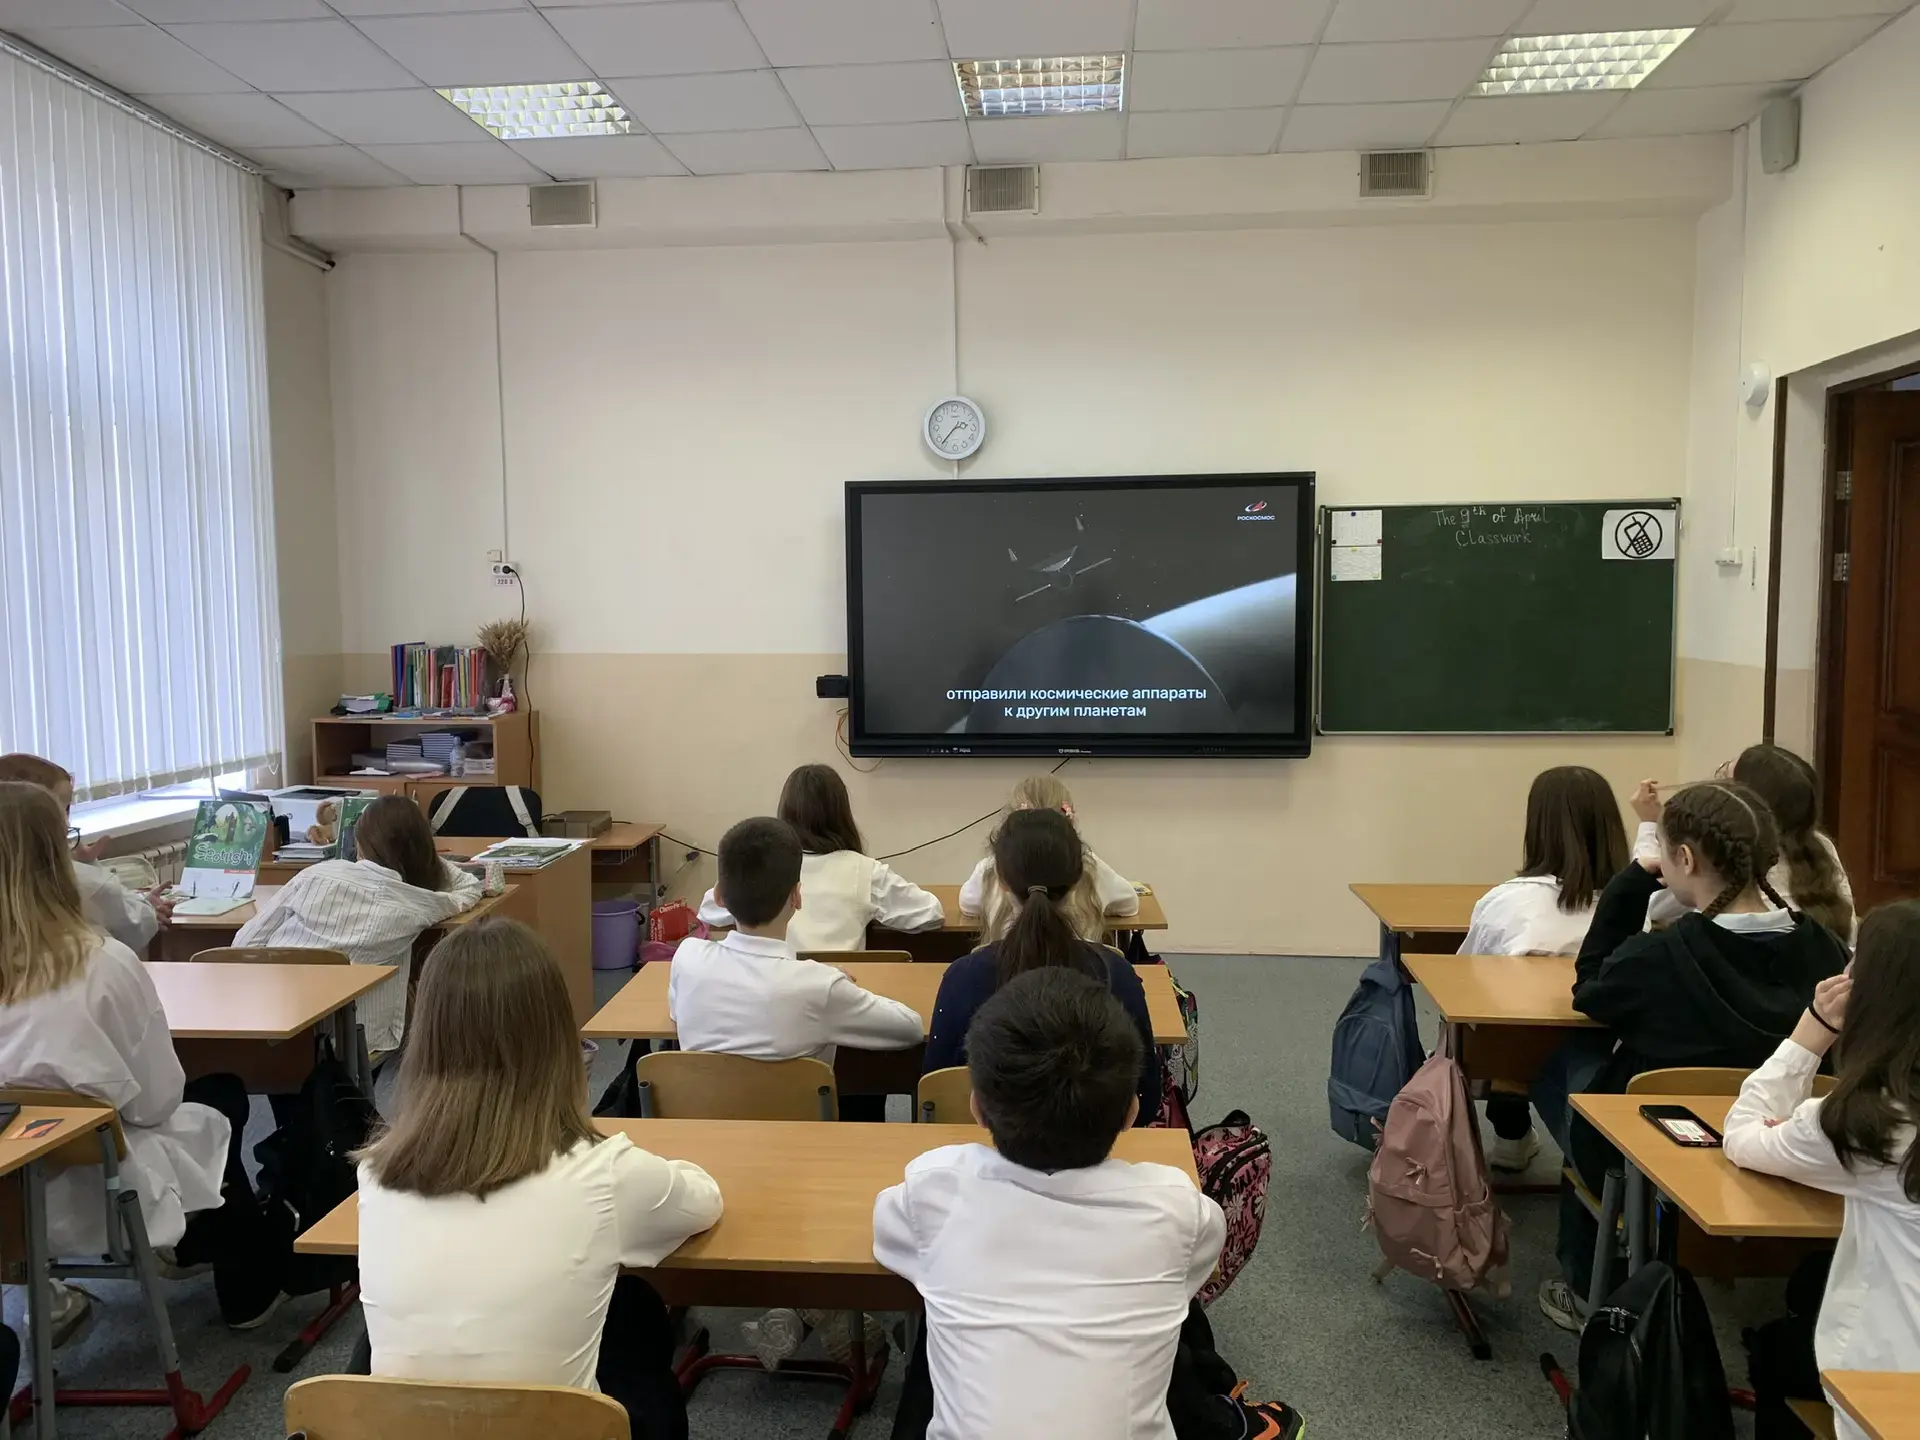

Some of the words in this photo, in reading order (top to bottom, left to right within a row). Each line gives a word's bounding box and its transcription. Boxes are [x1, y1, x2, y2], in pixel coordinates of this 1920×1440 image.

[951, 403, 959, 413] 12
[1431, 509, 1457, 526] The
[1492, 506, 1507, 523] of
[1513, 506, 1551, 530] April
[1455, 529, 1532, 547] Classwork
[946, 688, 1026, 703] отправили
[1030, 688, 1129, 700] космические
[1132, 688, 1207, 702] аппараты
[1004, 706, 1014, 717] к
[1016, 706, 1070, 720] другим
[1074, 706, 1147, 717] планетам
